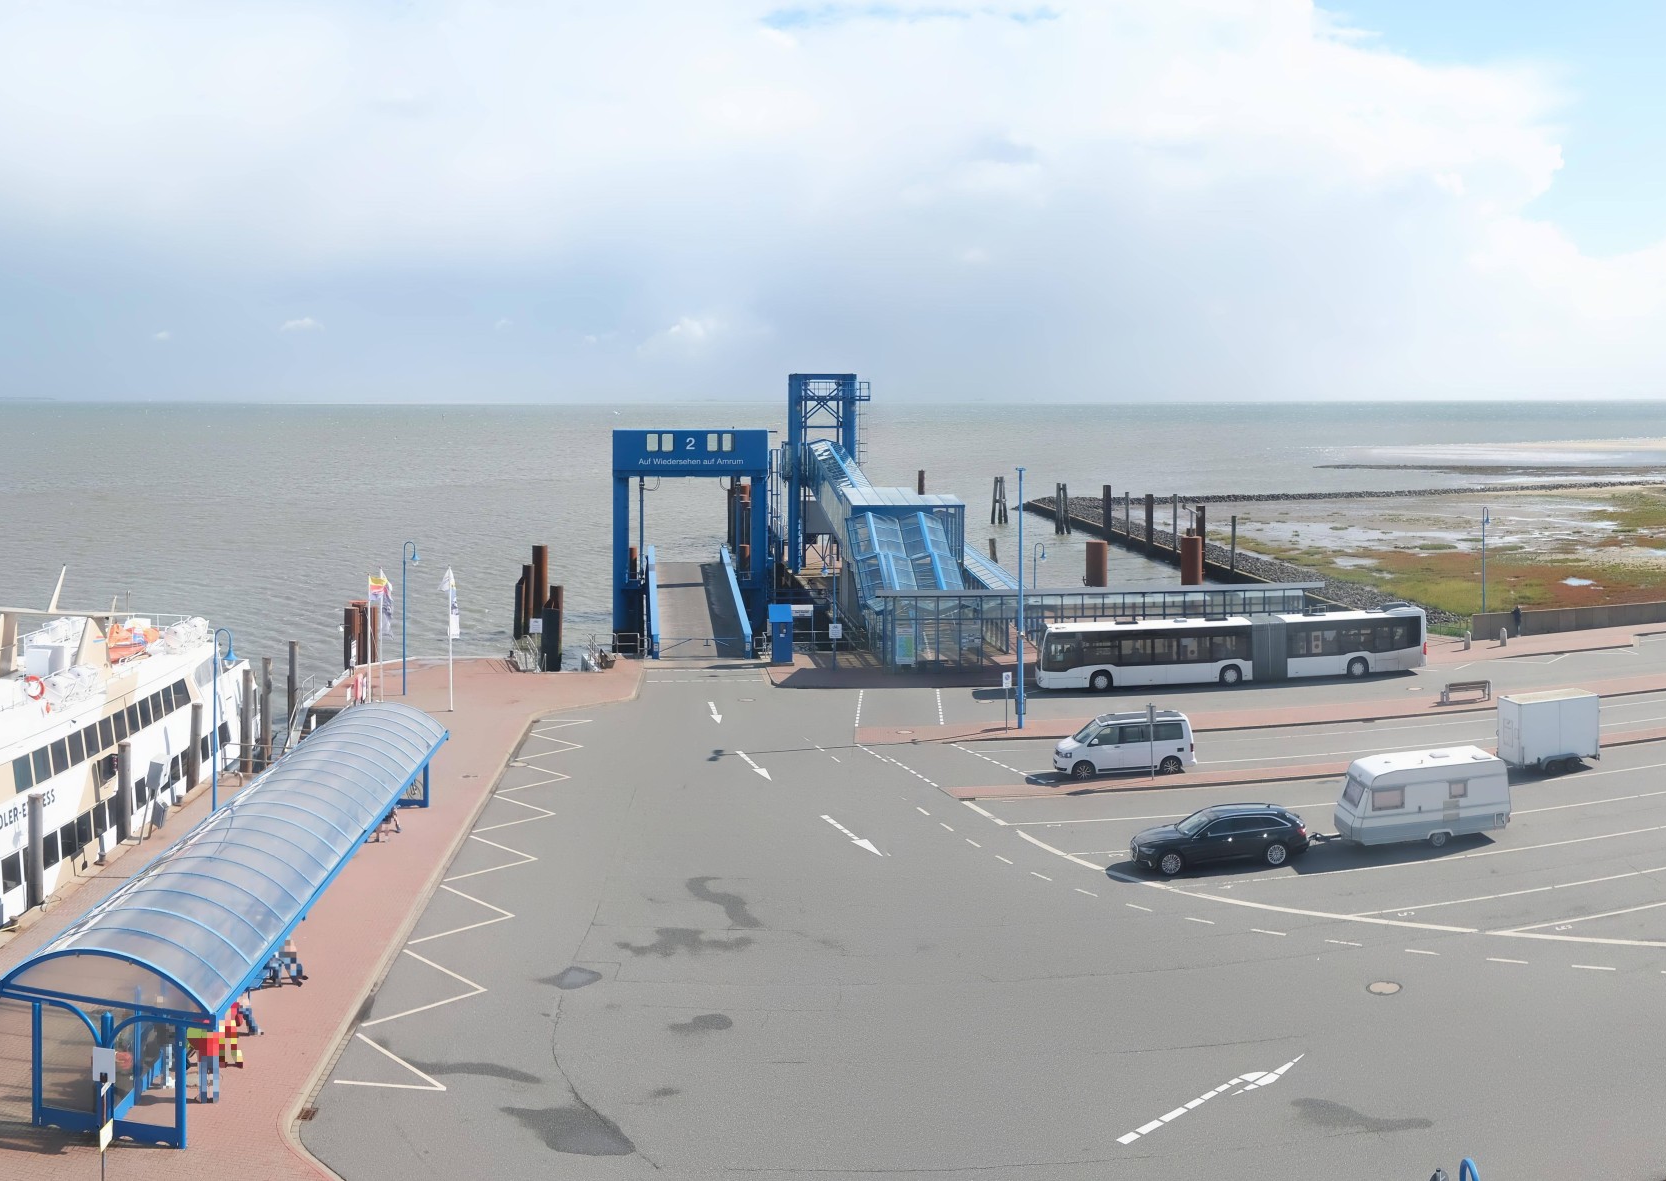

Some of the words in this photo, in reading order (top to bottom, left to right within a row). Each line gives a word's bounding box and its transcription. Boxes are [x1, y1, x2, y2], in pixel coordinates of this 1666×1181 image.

[685, 437, 696, 450] 2
[638, 458, 651, 466] Auf
[653, 458, 702, 466] Wiedersehen
[703, 458, 715, 466] auf
[717, 458, 745, 466] Amrum
